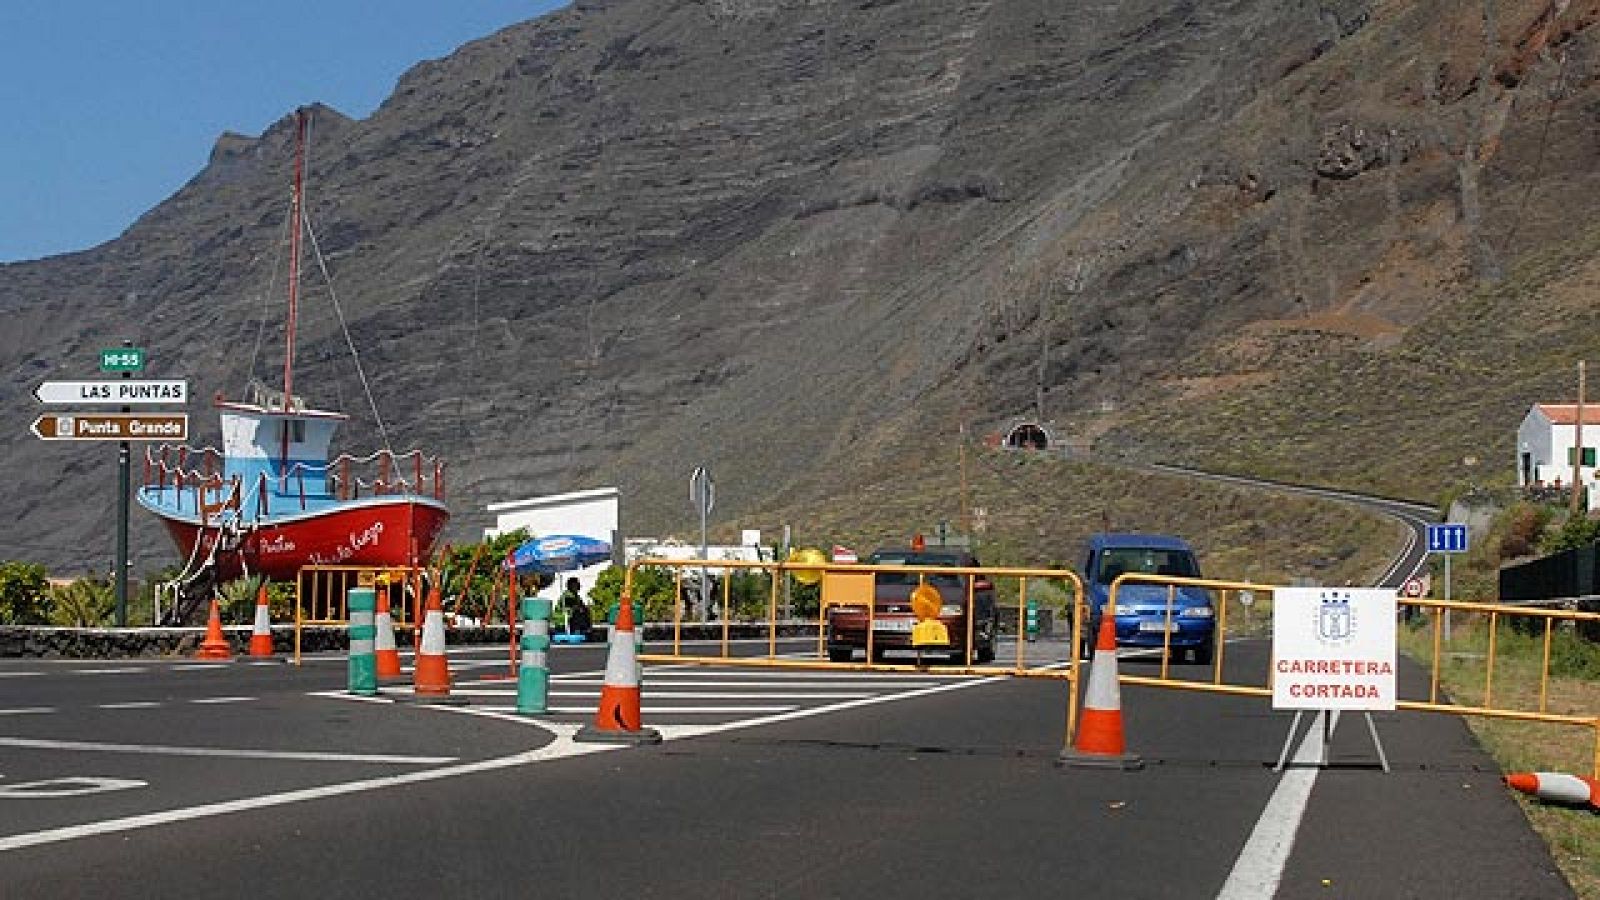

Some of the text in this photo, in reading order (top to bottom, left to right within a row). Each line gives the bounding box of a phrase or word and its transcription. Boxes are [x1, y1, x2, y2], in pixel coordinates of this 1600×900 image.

[80, 384, 182, 399] LAS PUNTAS
[79, 419, 181, 434] Punta Grande
[1277, 659, 1393, 675] CARRETERA
[1289, 684, 1380, 699] CORTADA
